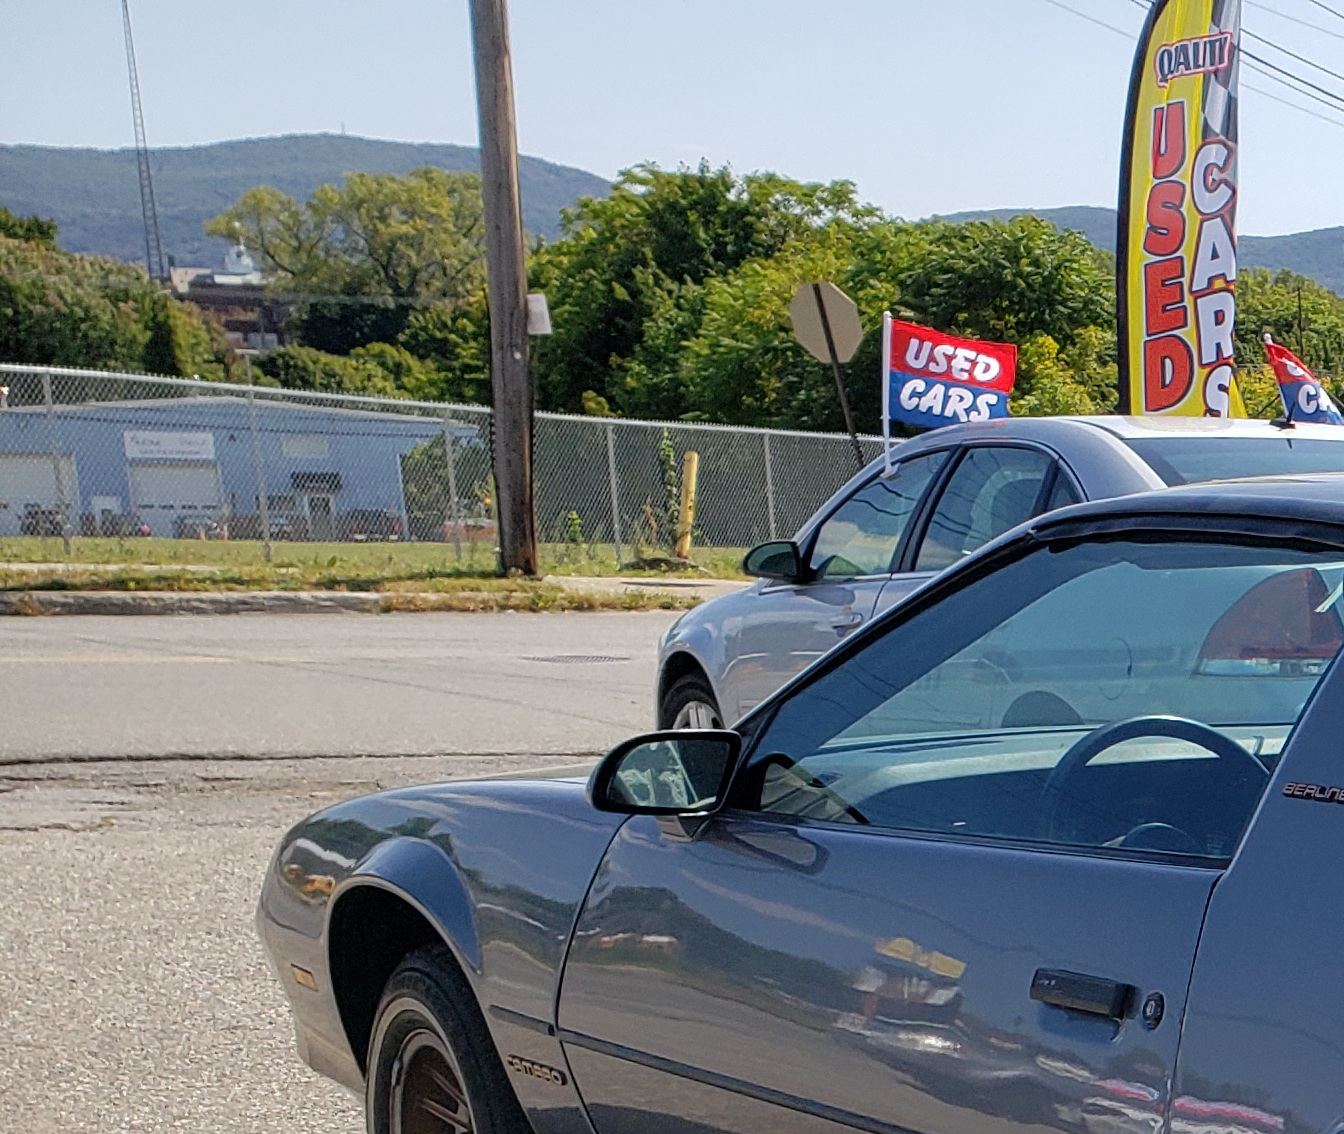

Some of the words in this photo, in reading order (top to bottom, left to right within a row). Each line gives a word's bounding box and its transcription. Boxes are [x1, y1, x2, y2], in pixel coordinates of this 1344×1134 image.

[1158, 35, 1229, 83] QALITY
[1143, 100, 1195, 414] USED
[904, 337, 1001, 382] USED
[900, 378, 999, 423] CARS
[1298, 384, 1342, 415] CA
